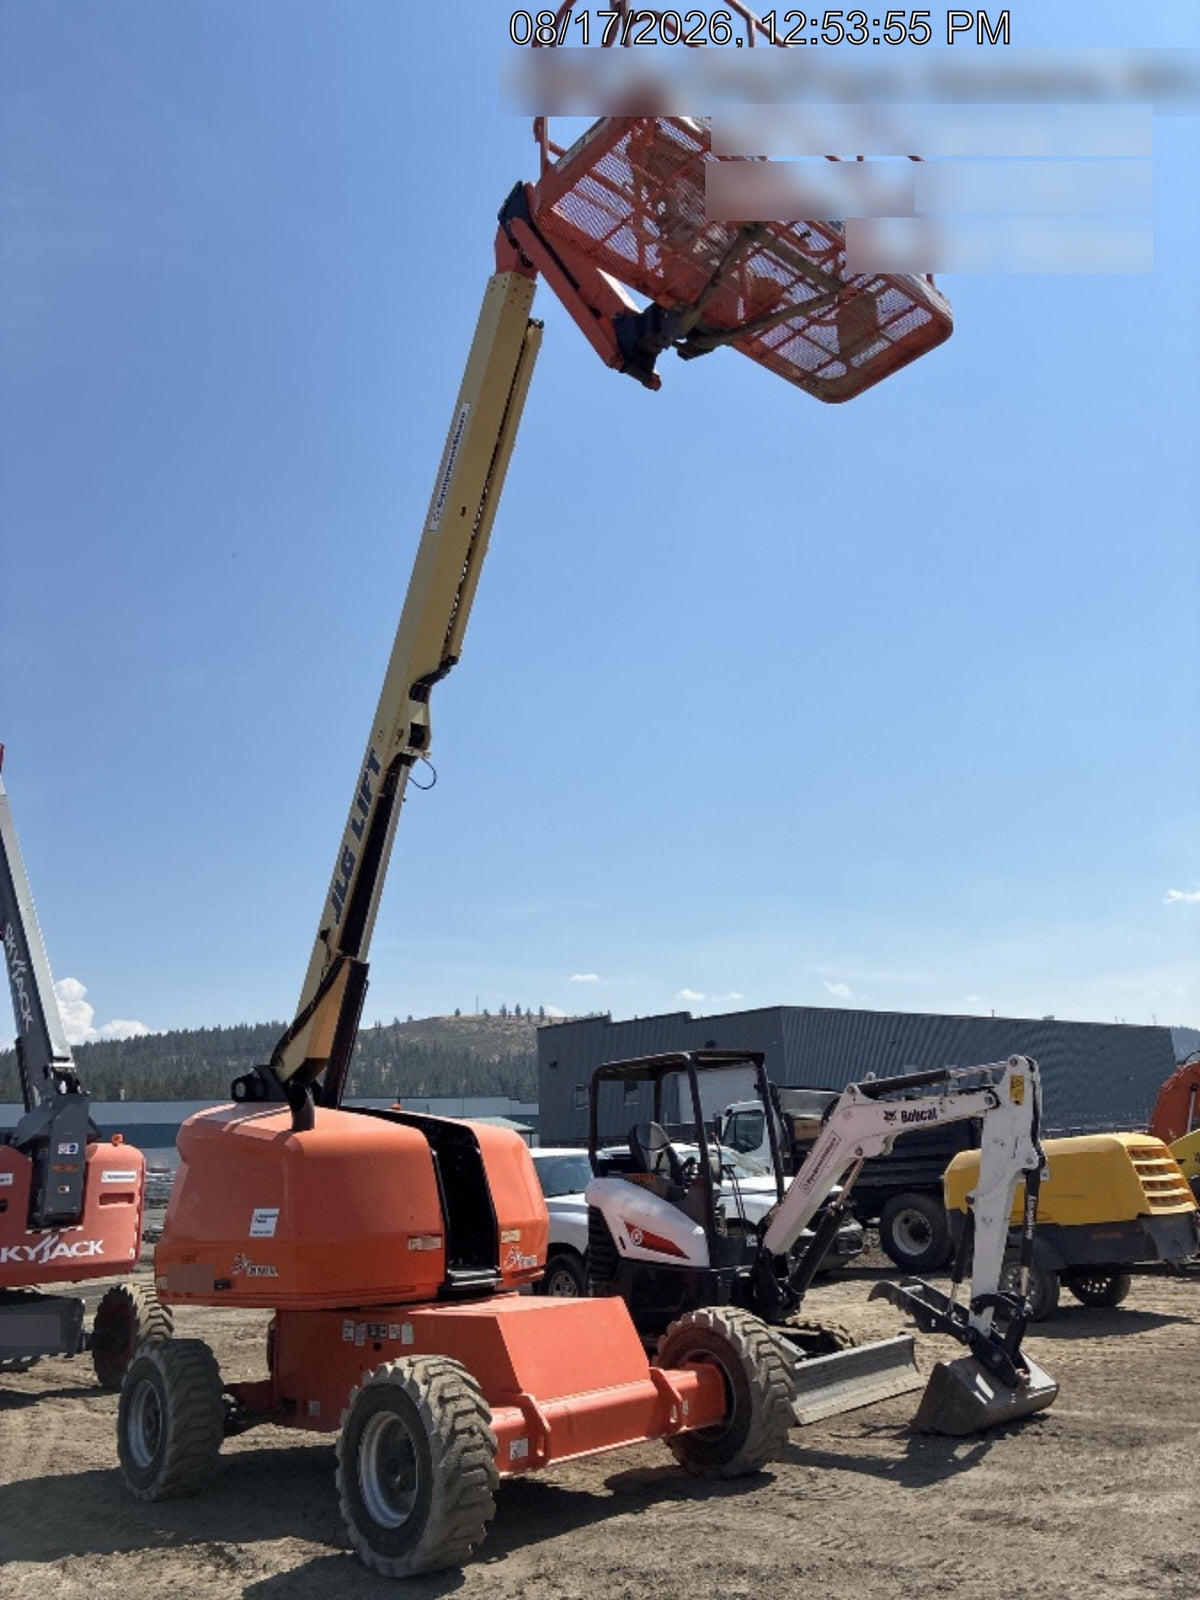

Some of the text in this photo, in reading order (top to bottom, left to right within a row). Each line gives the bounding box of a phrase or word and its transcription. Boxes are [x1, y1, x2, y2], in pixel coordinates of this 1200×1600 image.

[331, 747, 381, 925] JLG LIFT
[901, 1107, 938, 1123] Bobcat
[0, 1234, 104, 1264] KYJACK
